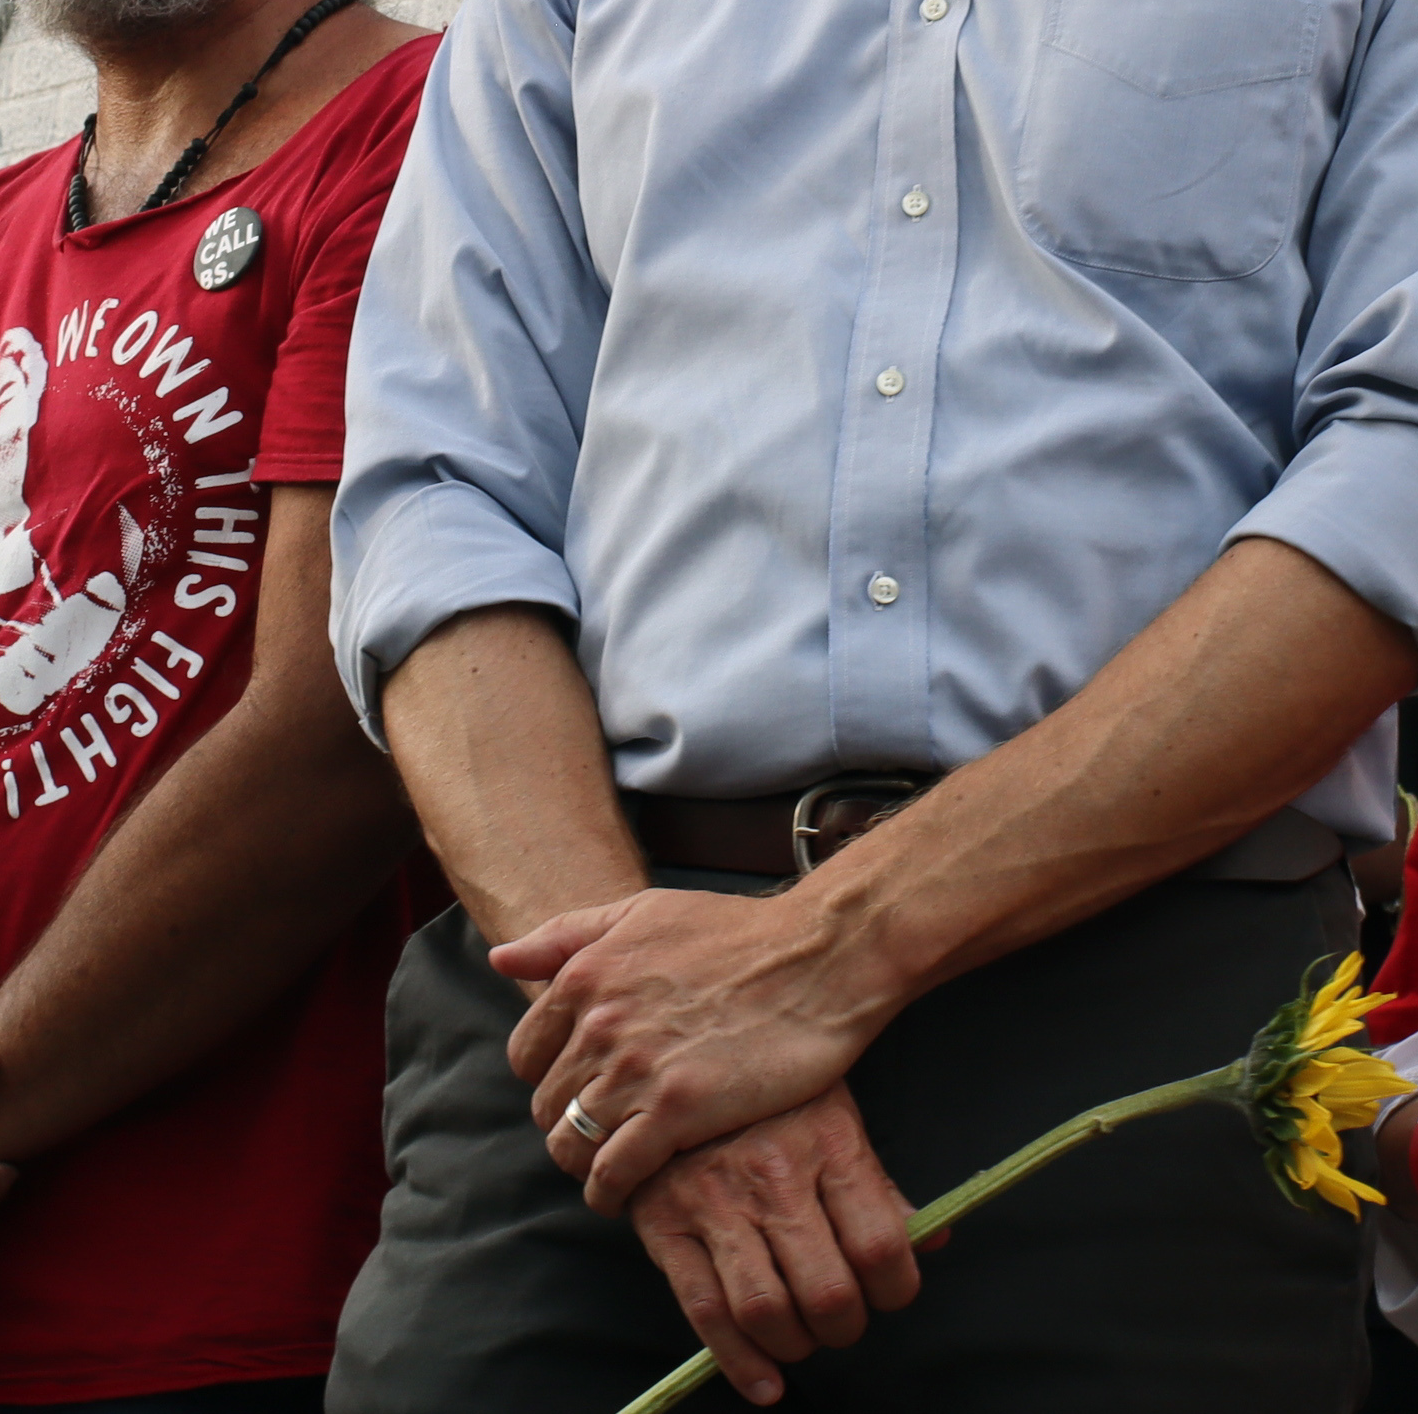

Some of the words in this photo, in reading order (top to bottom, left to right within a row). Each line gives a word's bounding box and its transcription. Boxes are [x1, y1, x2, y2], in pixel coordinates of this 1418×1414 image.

[199, 222, 260, 265] CALL
[204, 206, 239, 240] WE
[199, 260, 235, 291] BS.
[55, 297, 121, 368] WE
[112, 310, 245, 445] OWN
[173, 456, 261, 619] THIS
[3, 629, 205, 820] FIGHT!
